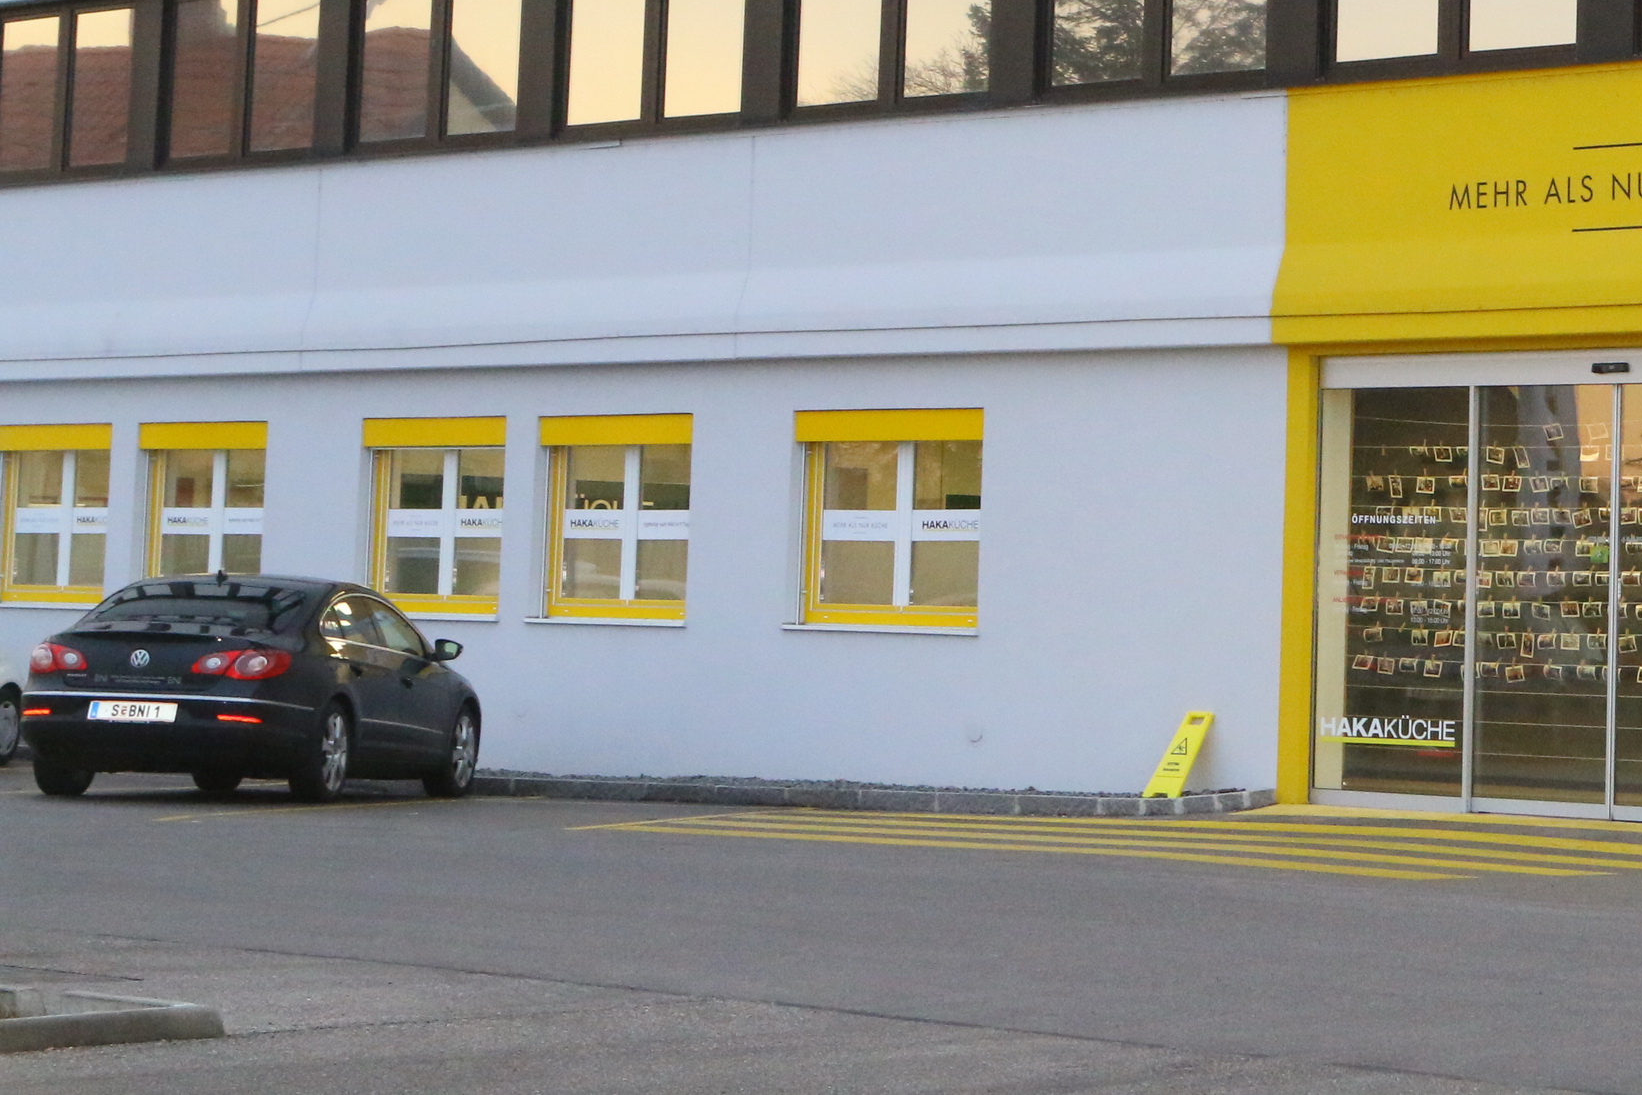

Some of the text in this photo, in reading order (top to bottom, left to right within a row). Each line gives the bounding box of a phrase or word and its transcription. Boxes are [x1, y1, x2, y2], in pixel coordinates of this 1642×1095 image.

[1449, 179, 1528, 211] MEHR
[1544, 174, 1594, 205] ALS
[922, 519, 979, 530] HAKAKÜCHE
[1351, 513, 1437, 525] ÖFFNUNGSZEITEN
[111, 704, 160, 718] S BNI 1
[1320, 715, 1455, 741] HAKAKÜCHE
